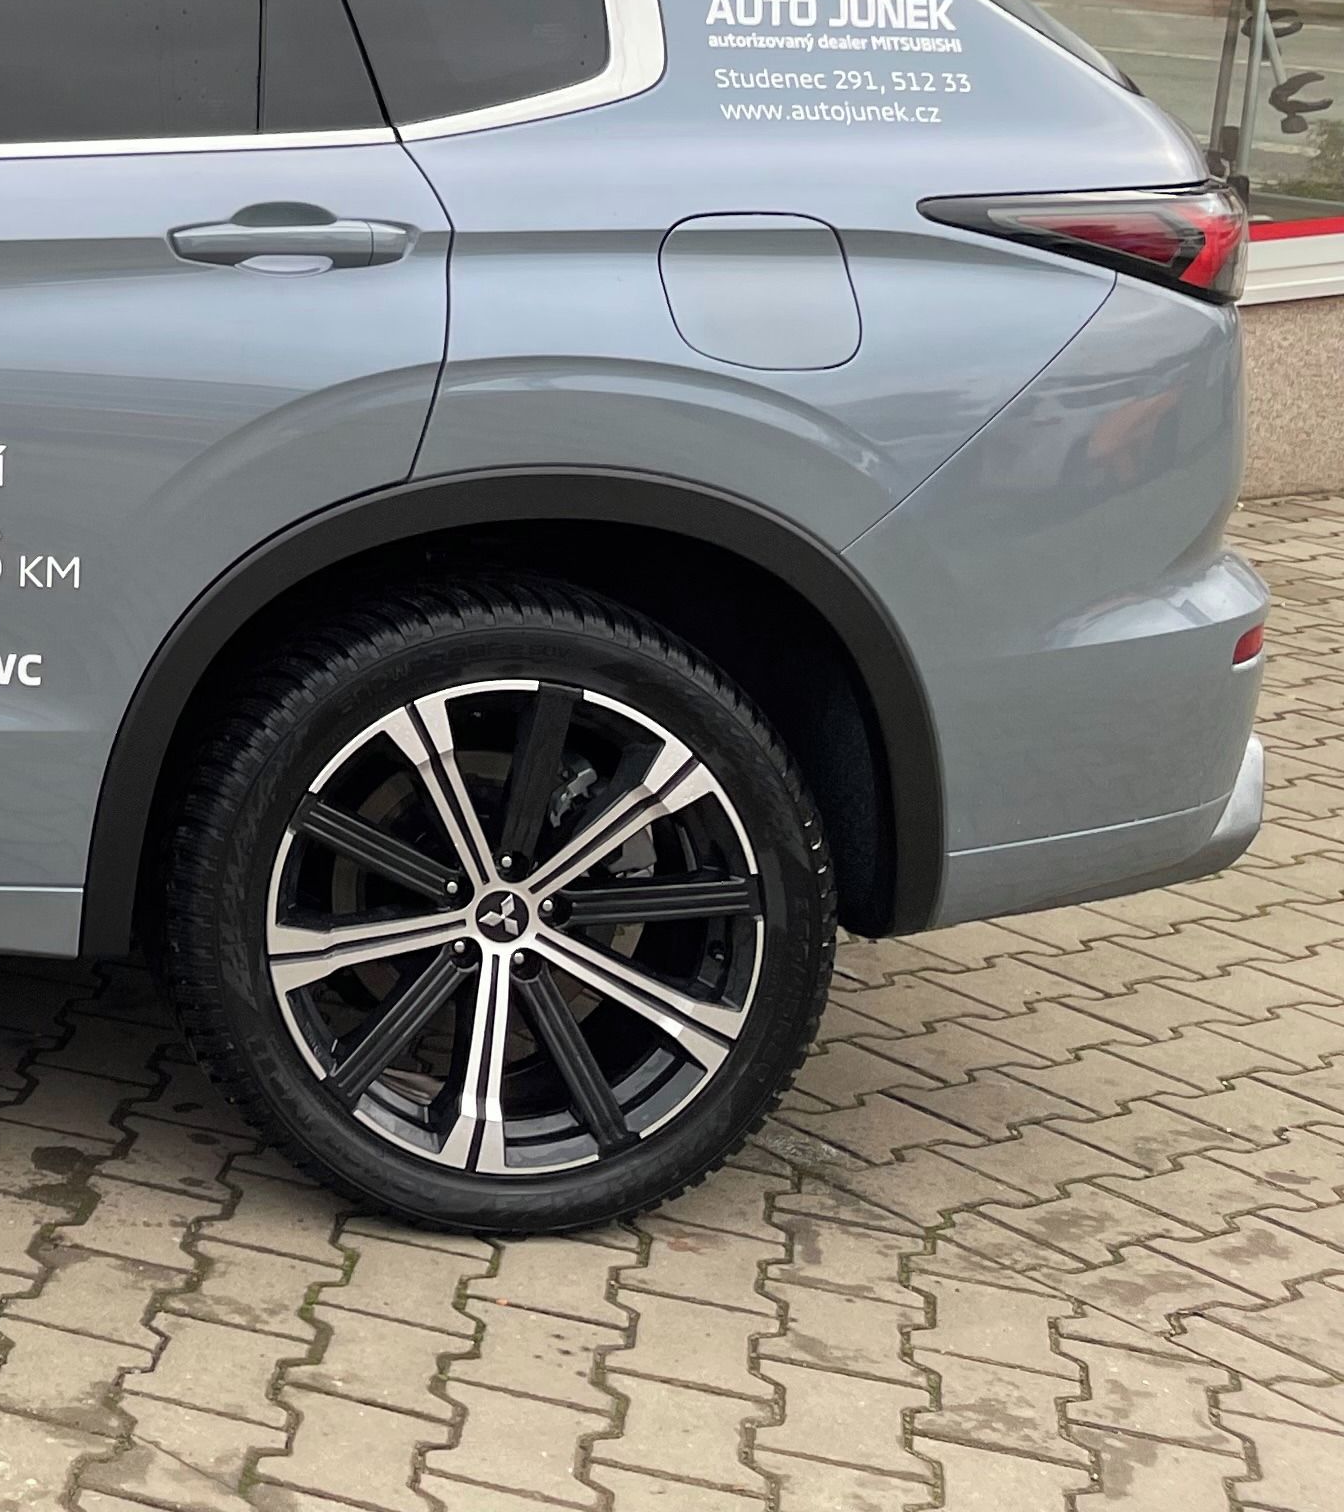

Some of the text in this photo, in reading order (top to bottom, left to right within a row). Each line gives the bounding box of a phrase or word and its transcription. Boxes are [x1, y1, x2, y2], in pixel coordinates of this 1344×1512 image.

[708, 33, 961, 53] autorizovaný dealer MITSUBISHI
[715, 68, 971, 94] Studenec 291, 512 33
[721, 100, 941, 124] www.autojunek.cz
[18, 555, 80, 589] KM
